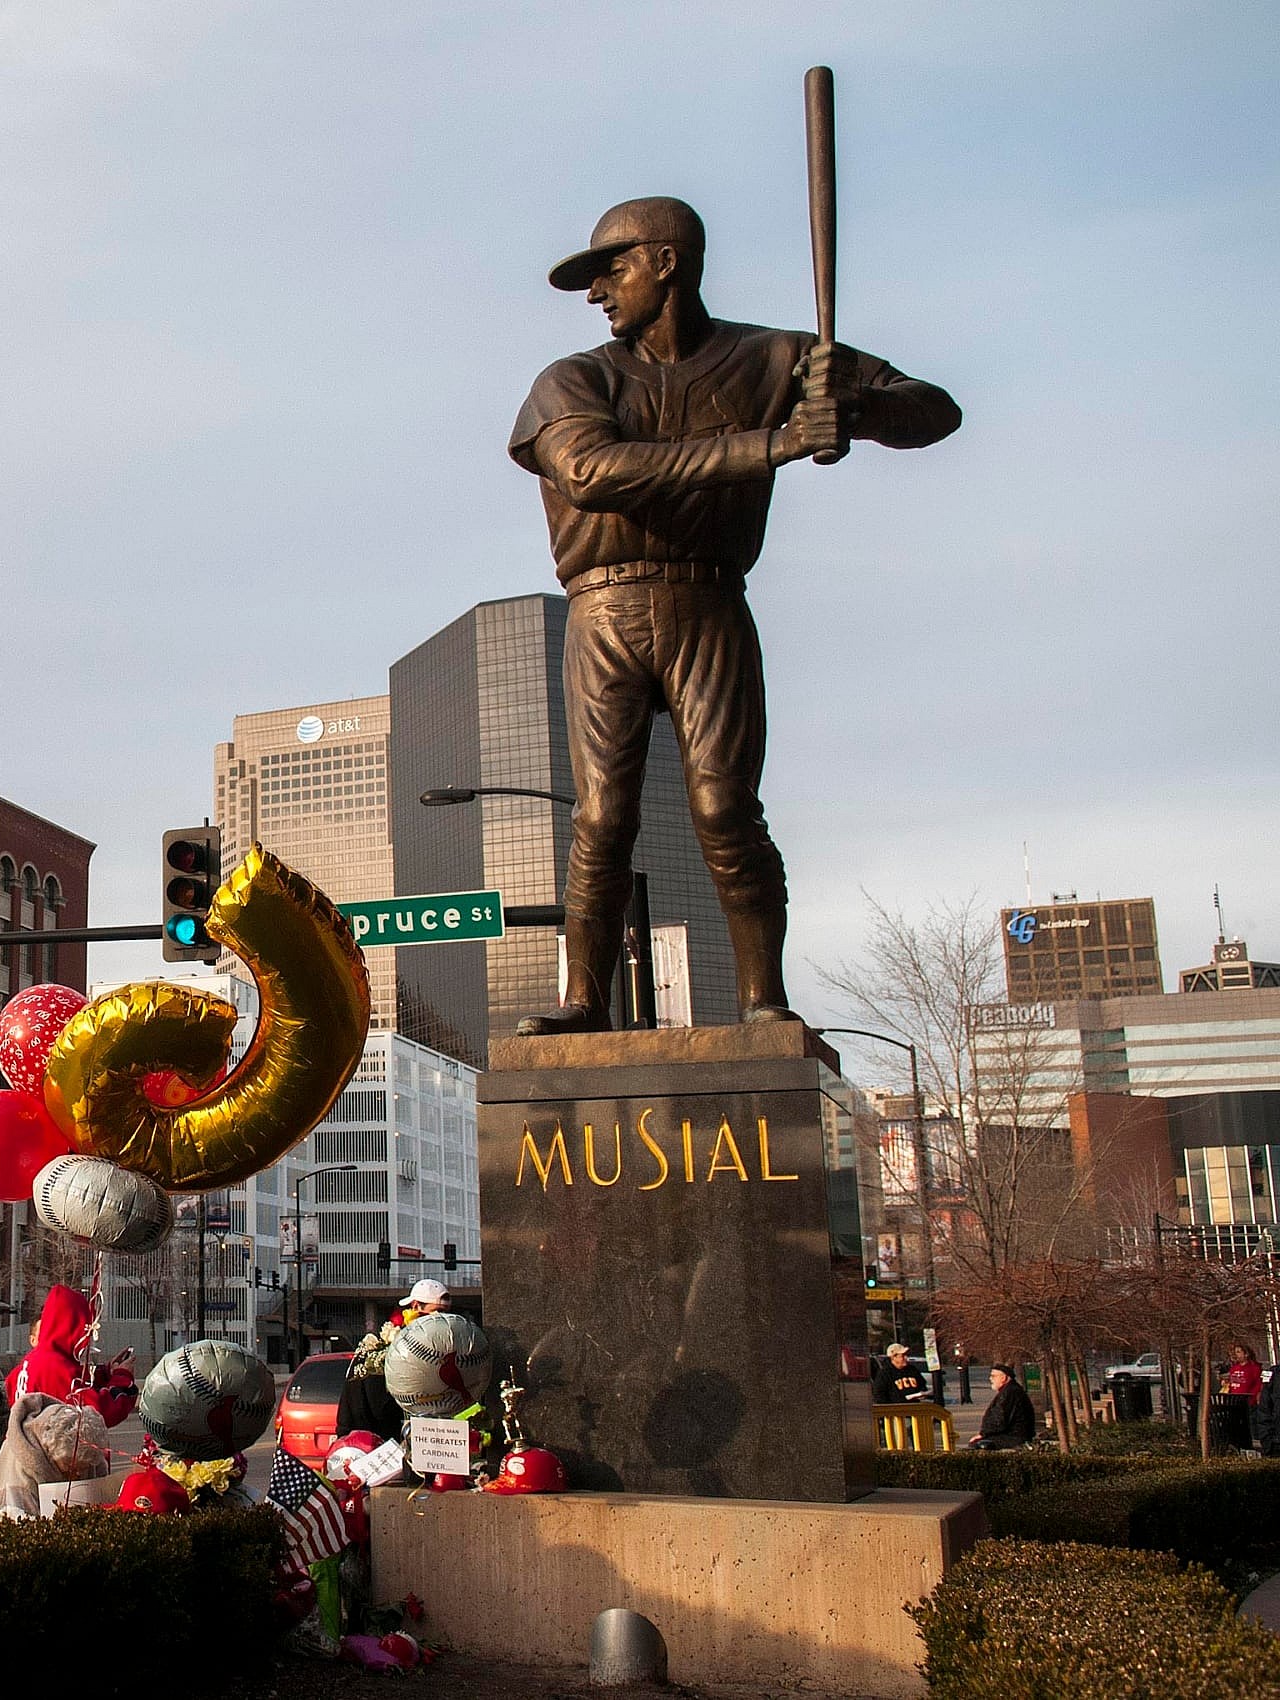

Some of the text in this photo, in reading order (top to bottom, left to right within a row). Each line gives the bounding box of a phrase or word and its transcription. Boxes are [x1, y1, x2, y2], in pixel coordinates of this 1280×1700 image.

[327, 716, 361, 734] at&t
[351, 906, 493, 941] pruce St
[515, 1107, 799, 1192] MUSIAL
[414, 1436, 467, 1446] THE GREATEST
[421, 1449, 460, 1459] CARDINAL
